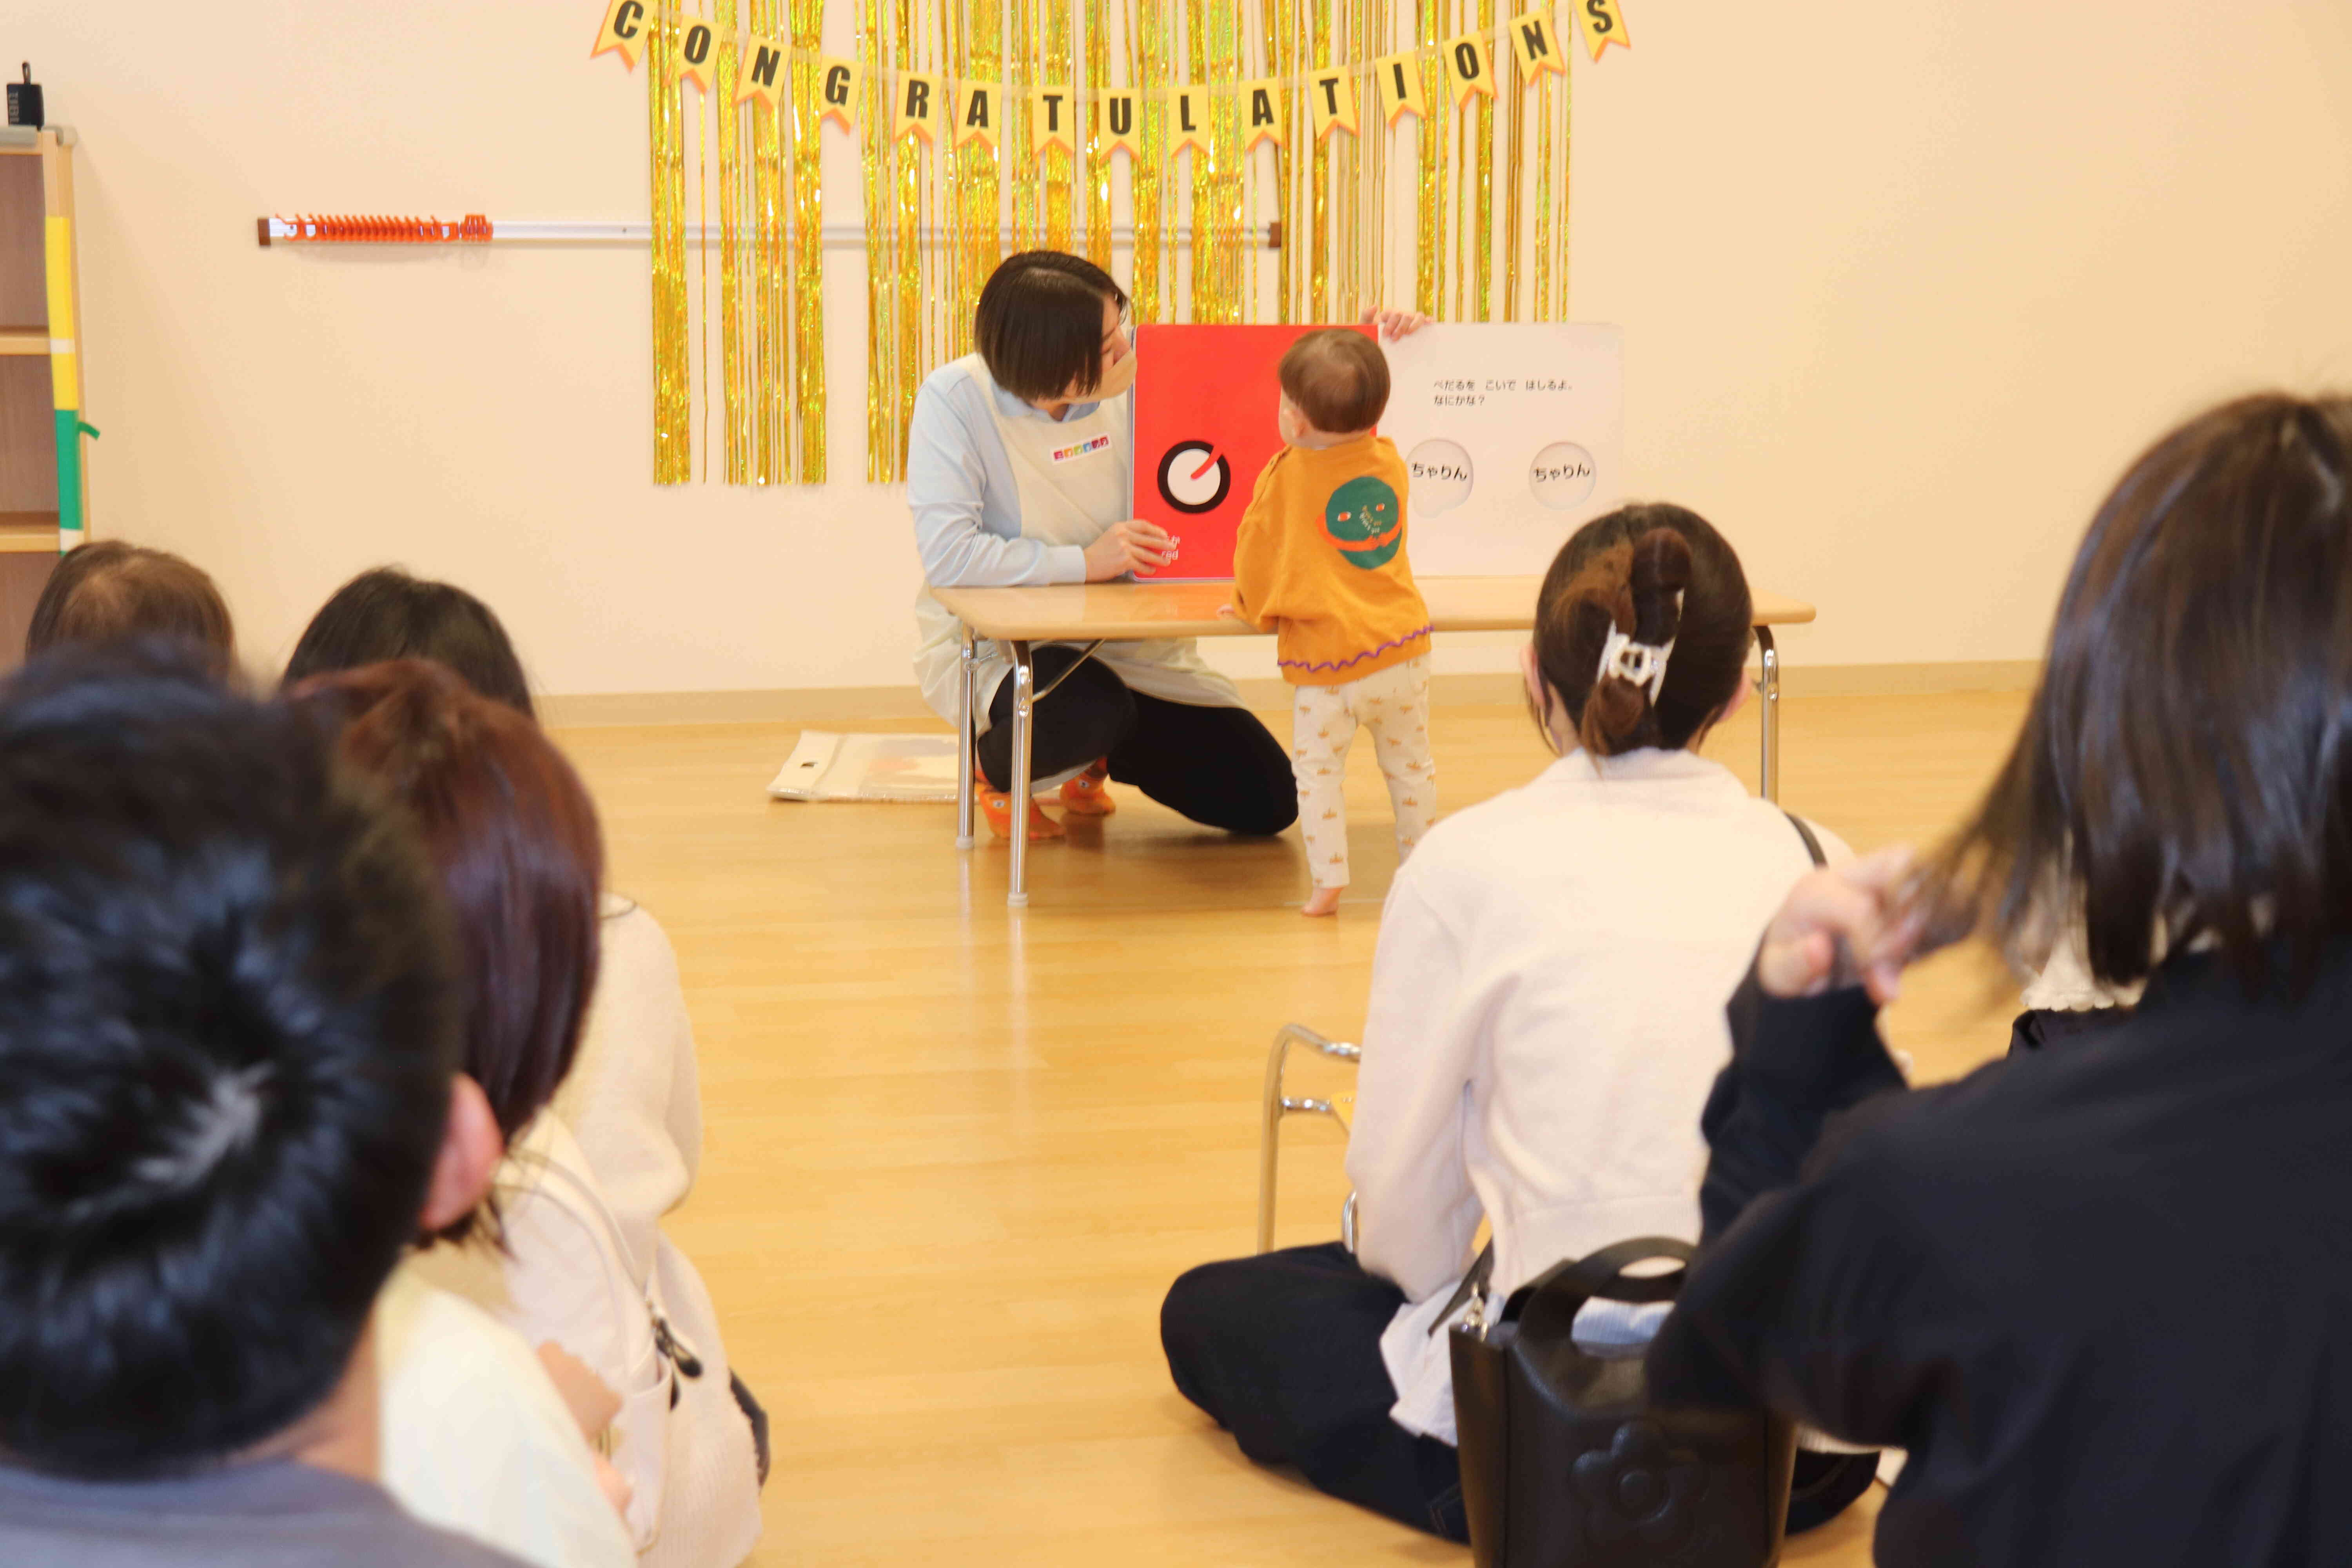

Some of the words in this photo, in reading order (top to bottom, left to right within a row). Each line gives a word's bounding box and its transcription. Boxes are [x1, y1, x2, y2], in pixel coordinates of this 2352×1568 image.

[614, 0, 1613, 136] CONGRATULATIONS
[1486, 379, 1515, 391] こいで
[1411, 462, 1467, 482] ちゃりん
[1534, 463, 1590, 483] ちゃりん
